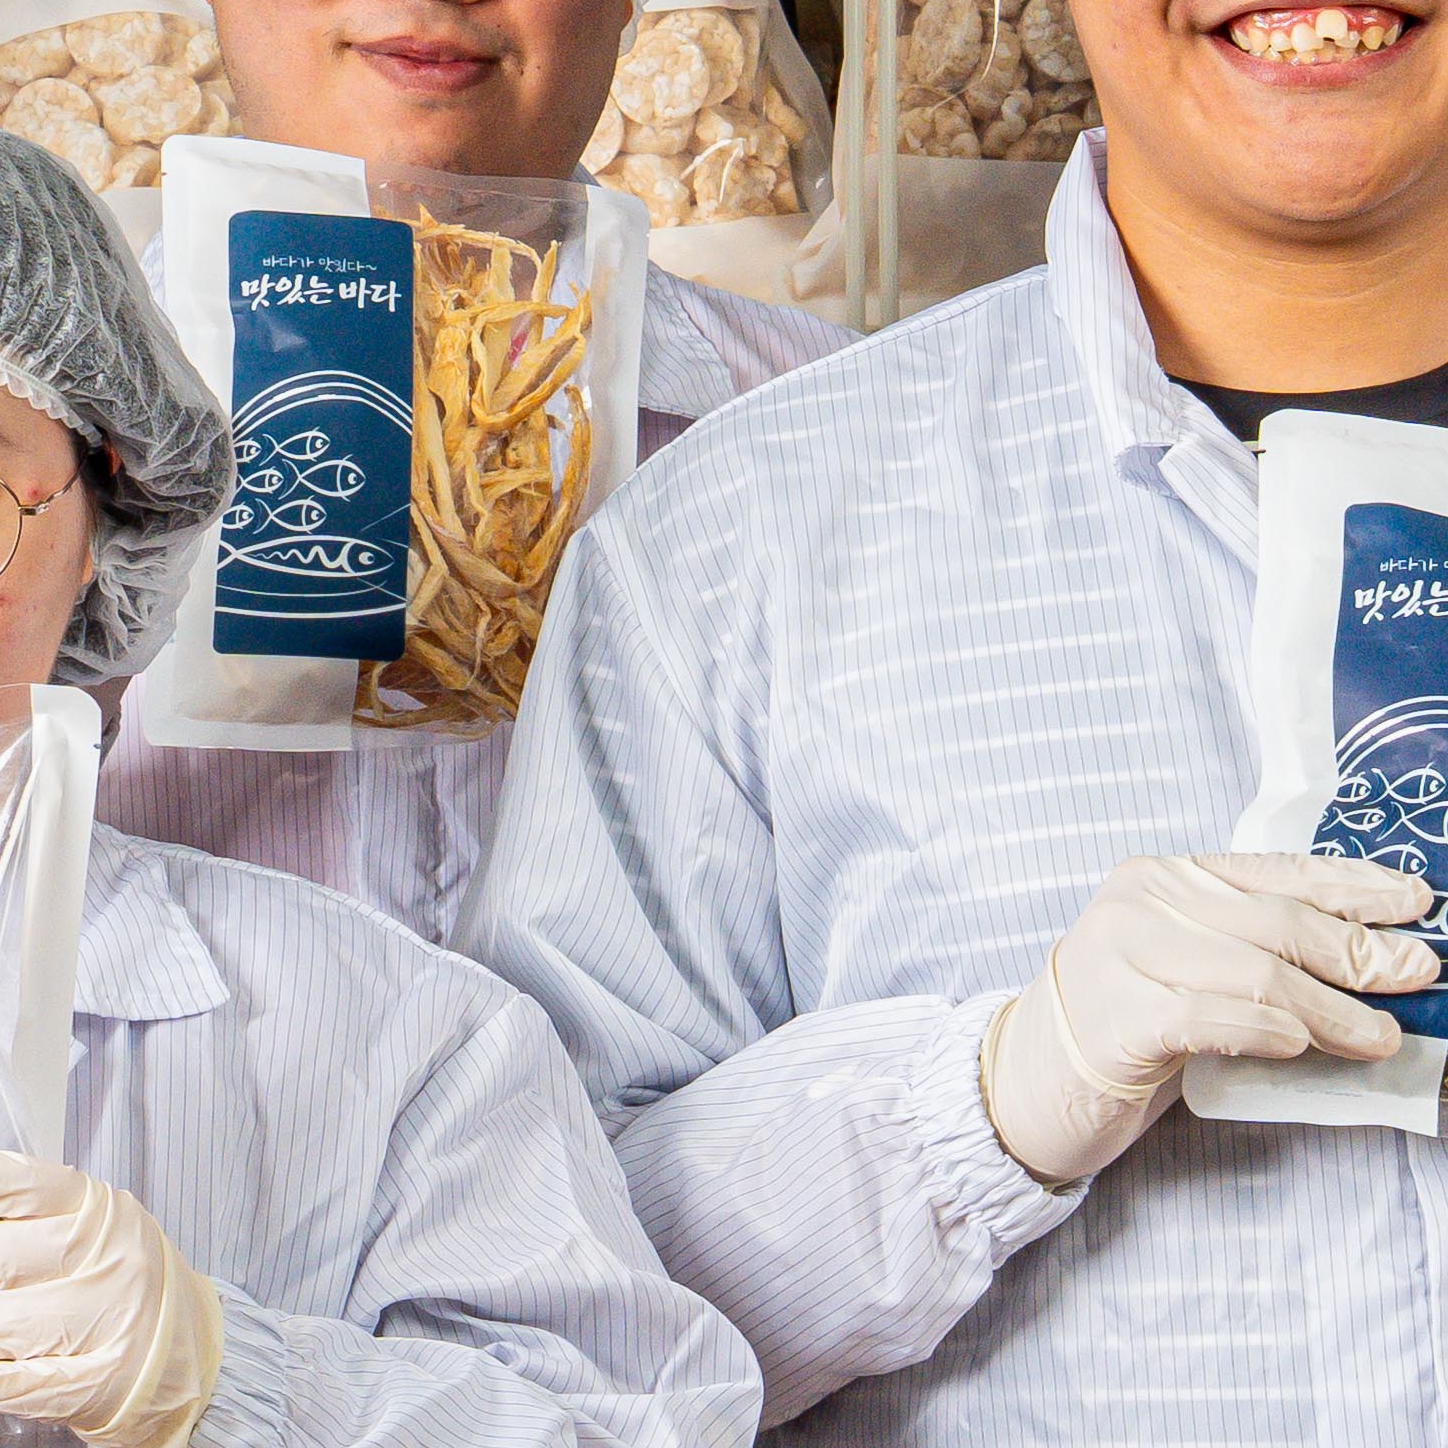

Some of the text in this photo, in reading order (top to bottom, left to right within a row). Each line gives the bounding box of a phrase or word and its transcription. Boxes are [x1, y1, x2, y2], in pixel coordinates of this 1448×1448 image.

[262, 254, 315, 268] 바다가
[240, 273, 402, 313] 맛있는 바다
[1379, 556, 1438, 573] 바다가
